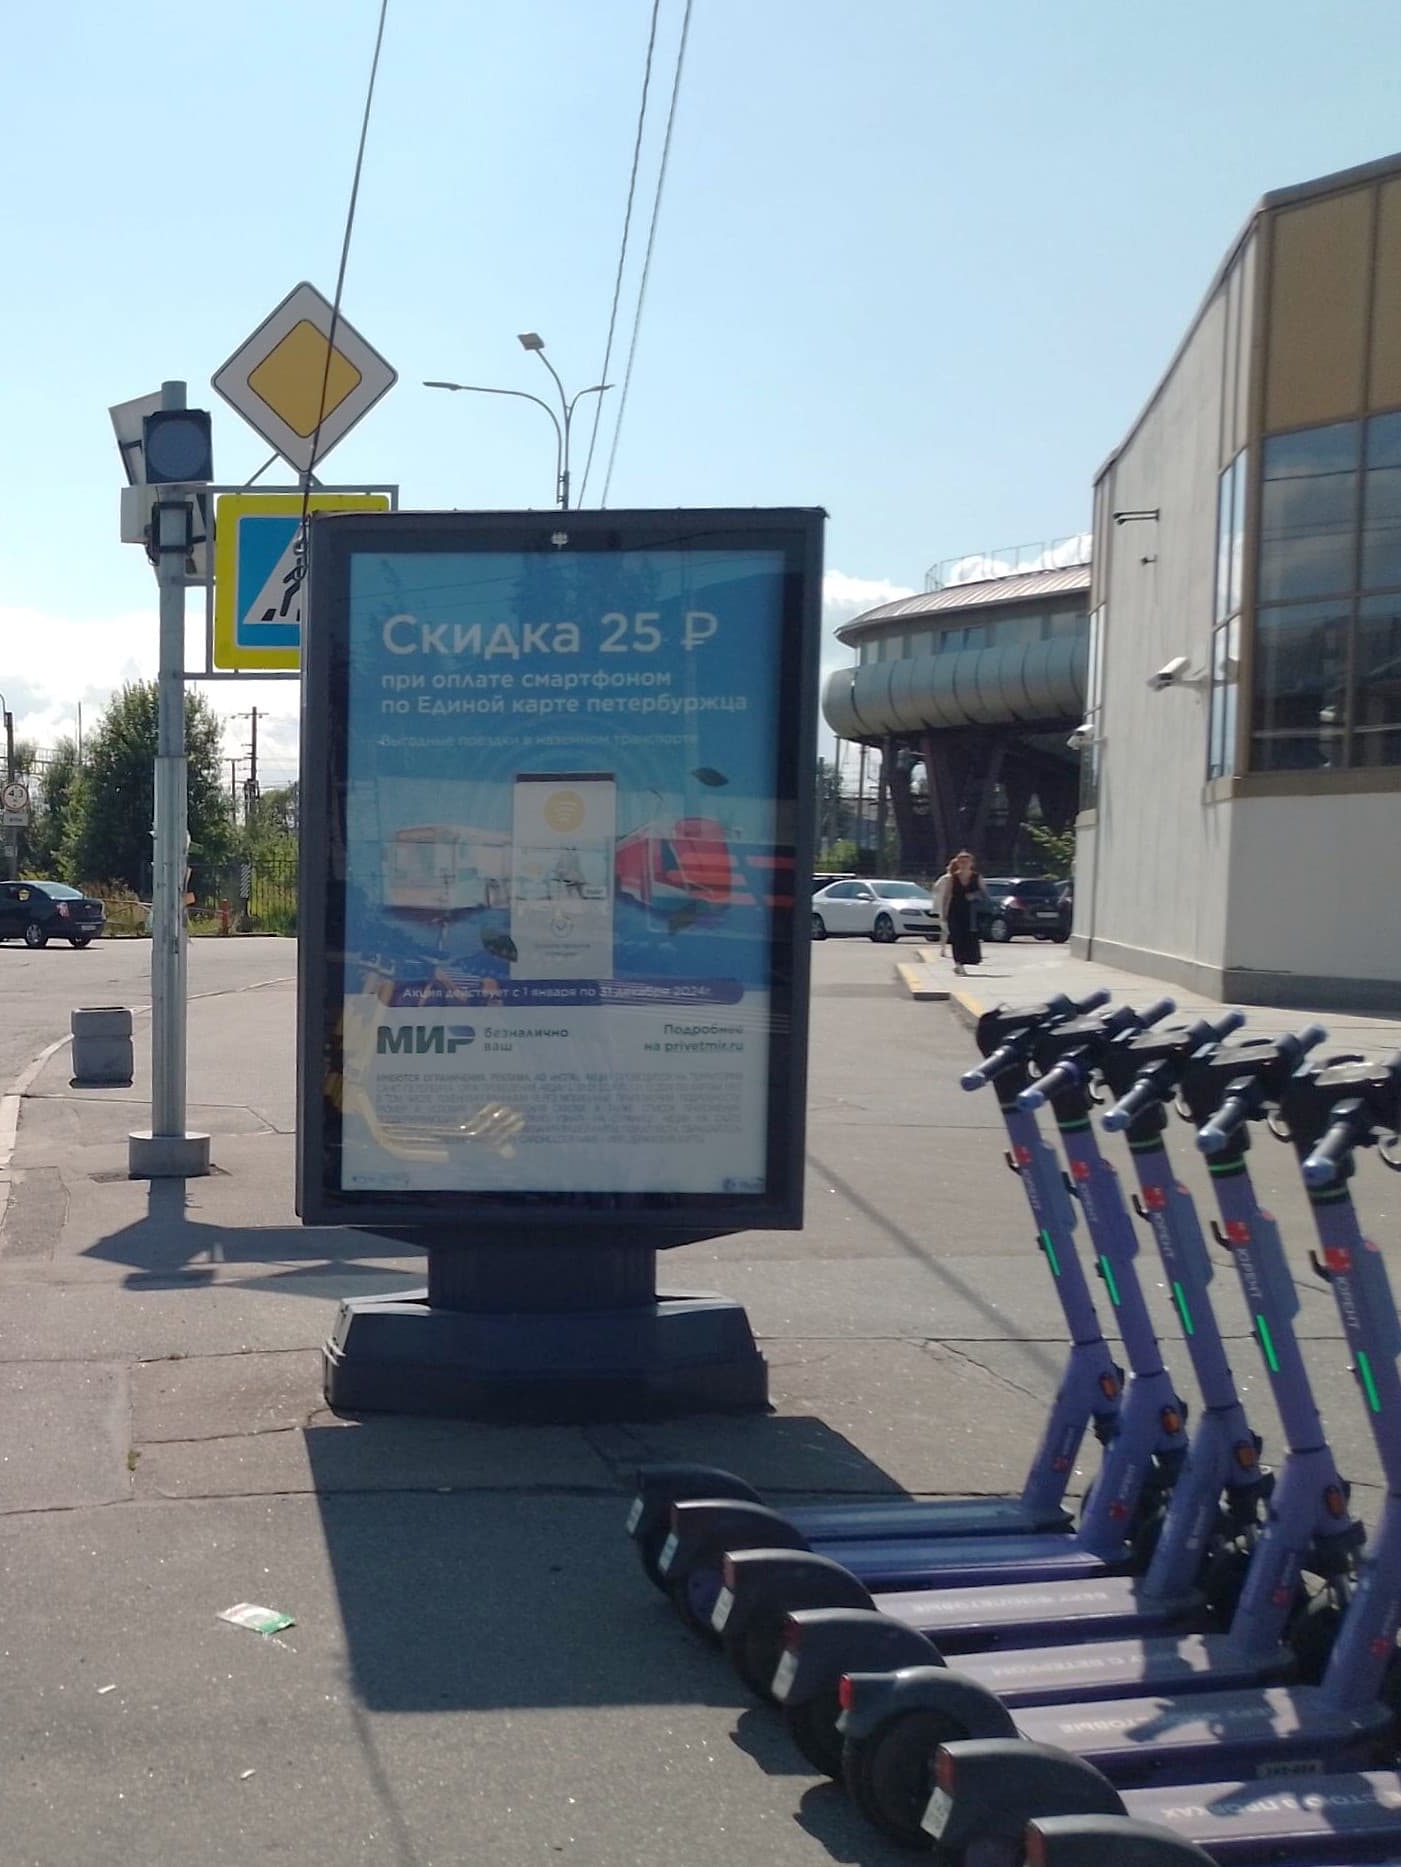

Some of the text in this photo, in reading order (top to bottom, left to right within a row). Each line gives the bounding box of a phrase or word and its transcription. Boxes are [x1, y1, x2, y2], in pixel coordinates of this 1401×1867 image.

[382, 614, 581, 659] Скидка
[600, 612, 661, 652] 25
[381, 669, 672, 692] при оплате смартфоном
[381, 693, 748, 716] по Единой карте петербуржца
[531, 988, 576, 1000] января
[579, 987, 596, 998] по
[376, 1025, 476, 1054] МИР
[484, 1026, 569, 1039] безналично
[484, 1042, 513, 1052] ваш
[643, 1042, 661, 1051] на
[1235, 1247, 1262, 1298] ЮРЕНТ
[1335, 1276, 1360, 1330] ЮРЕНТ
